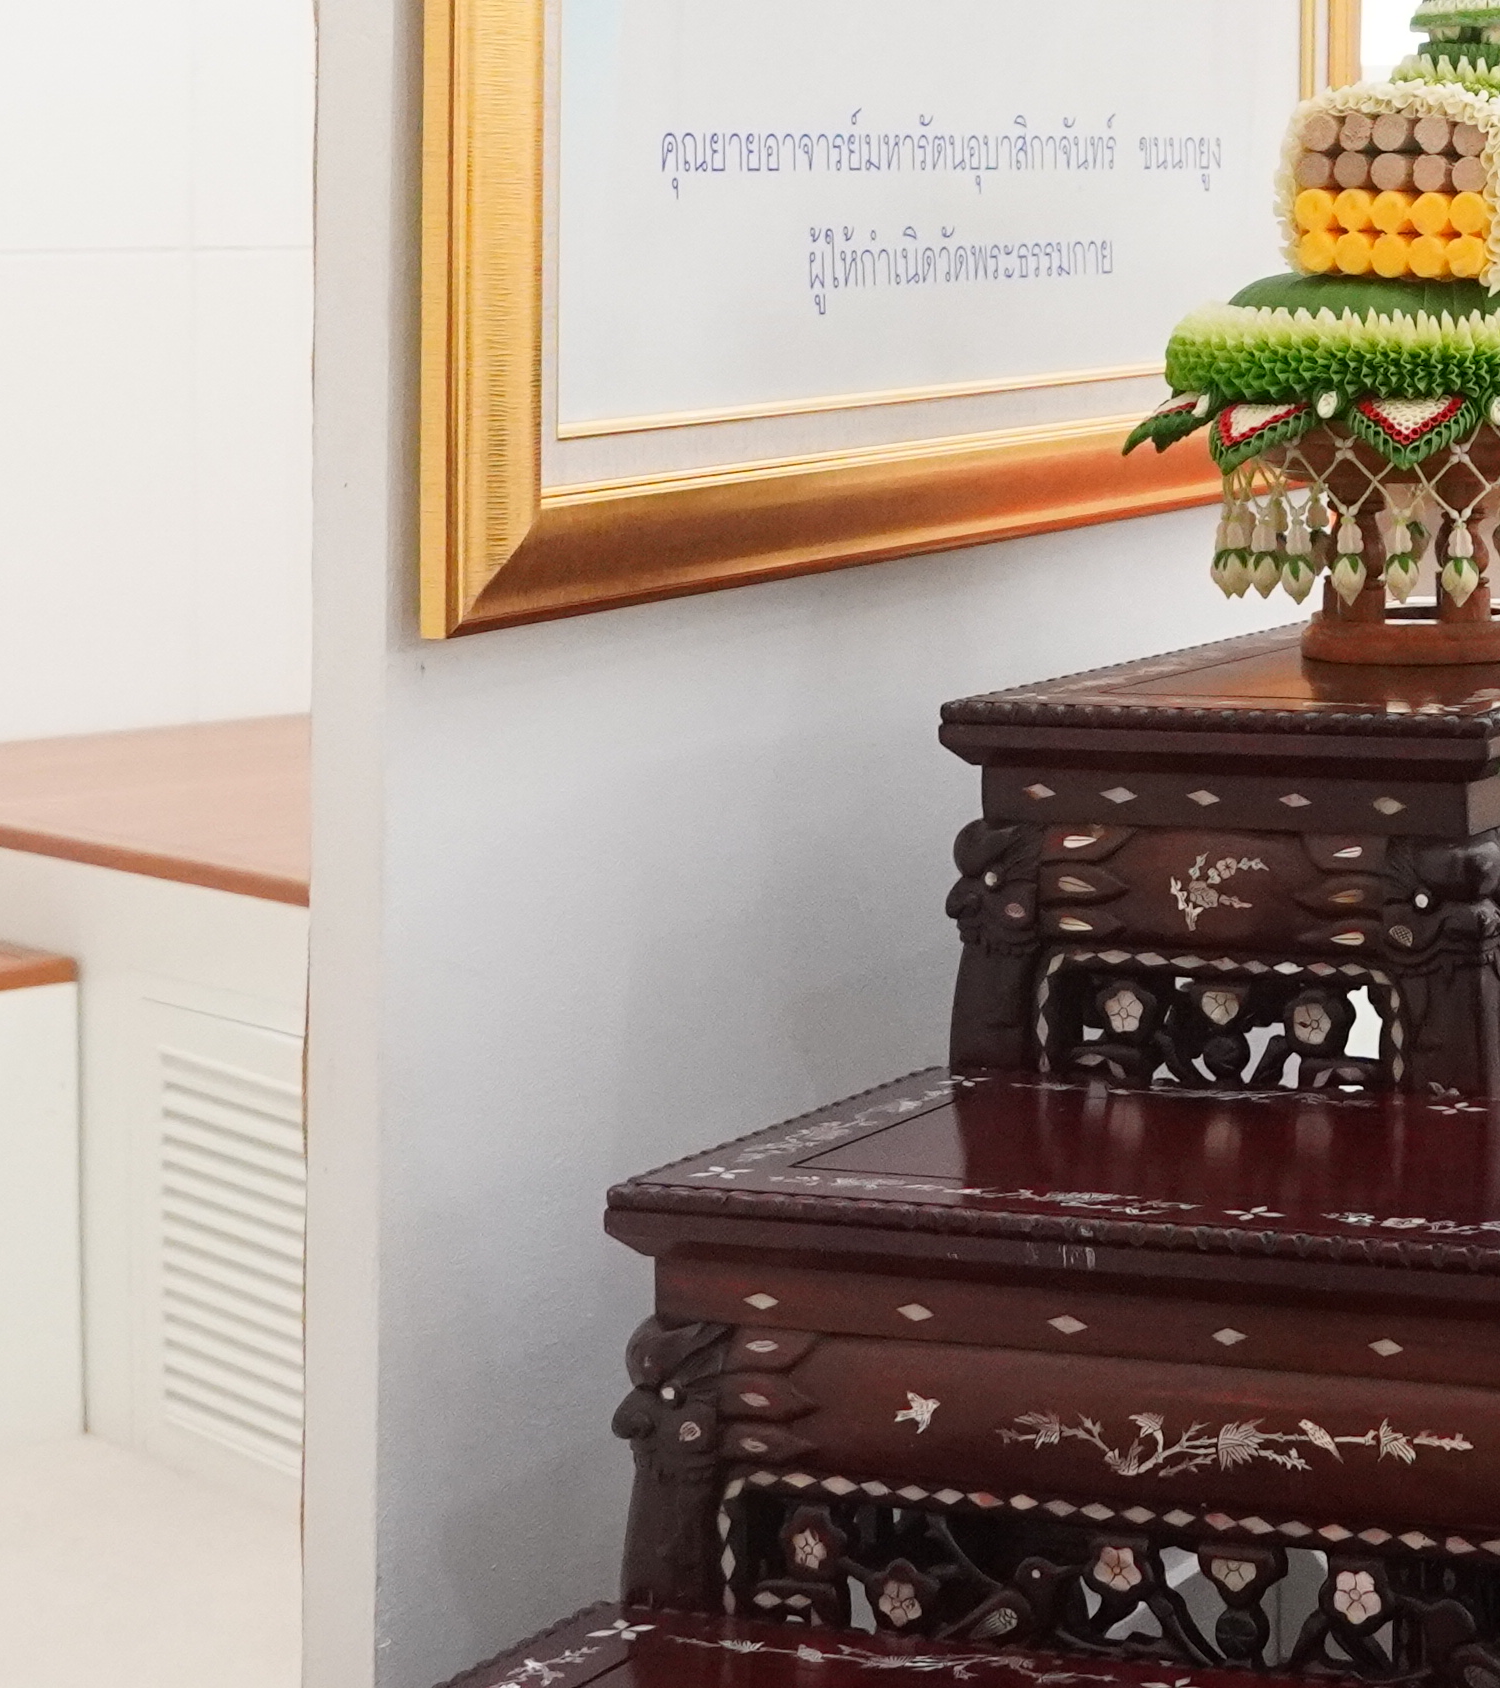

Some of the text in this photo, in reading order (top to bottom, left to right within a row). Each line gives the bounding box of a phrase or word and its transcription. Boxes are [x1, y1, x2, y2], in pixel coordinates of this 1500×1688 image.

[1138, 135, 1222, 192] ขนนกยูง
[808, 224, 1114, 316] ผู้ให้กำเนิดวัดพระธรรมกาย
